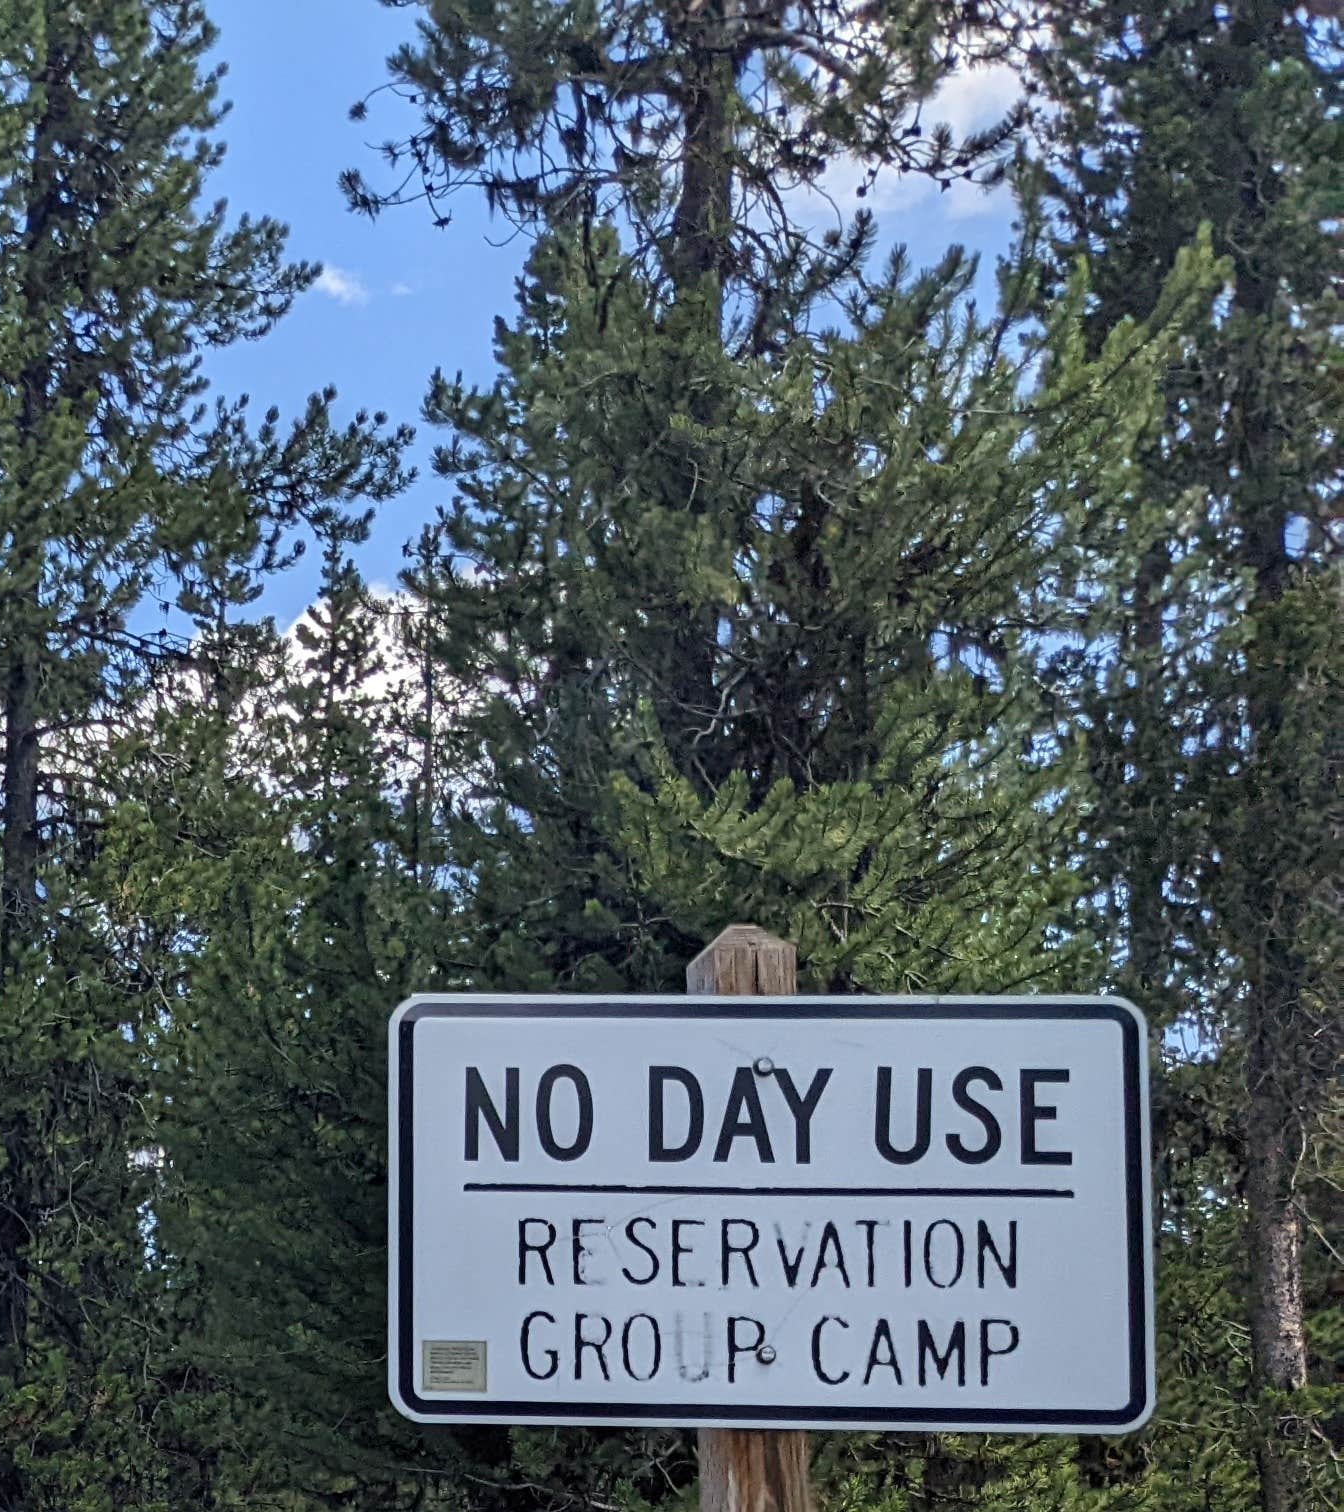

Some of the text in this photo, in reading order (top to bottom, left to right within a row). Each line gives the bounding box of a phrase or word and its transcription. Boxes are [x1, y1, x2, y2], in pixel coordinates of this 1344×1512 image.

[464, 1064, 1072, 1165] NO DAY USE
[518, 1217, 1017, 1290] RESERVATION
[520, 1310, 765, 1383] GROUP
[812, 1315, 1020, 1387] CAMP
